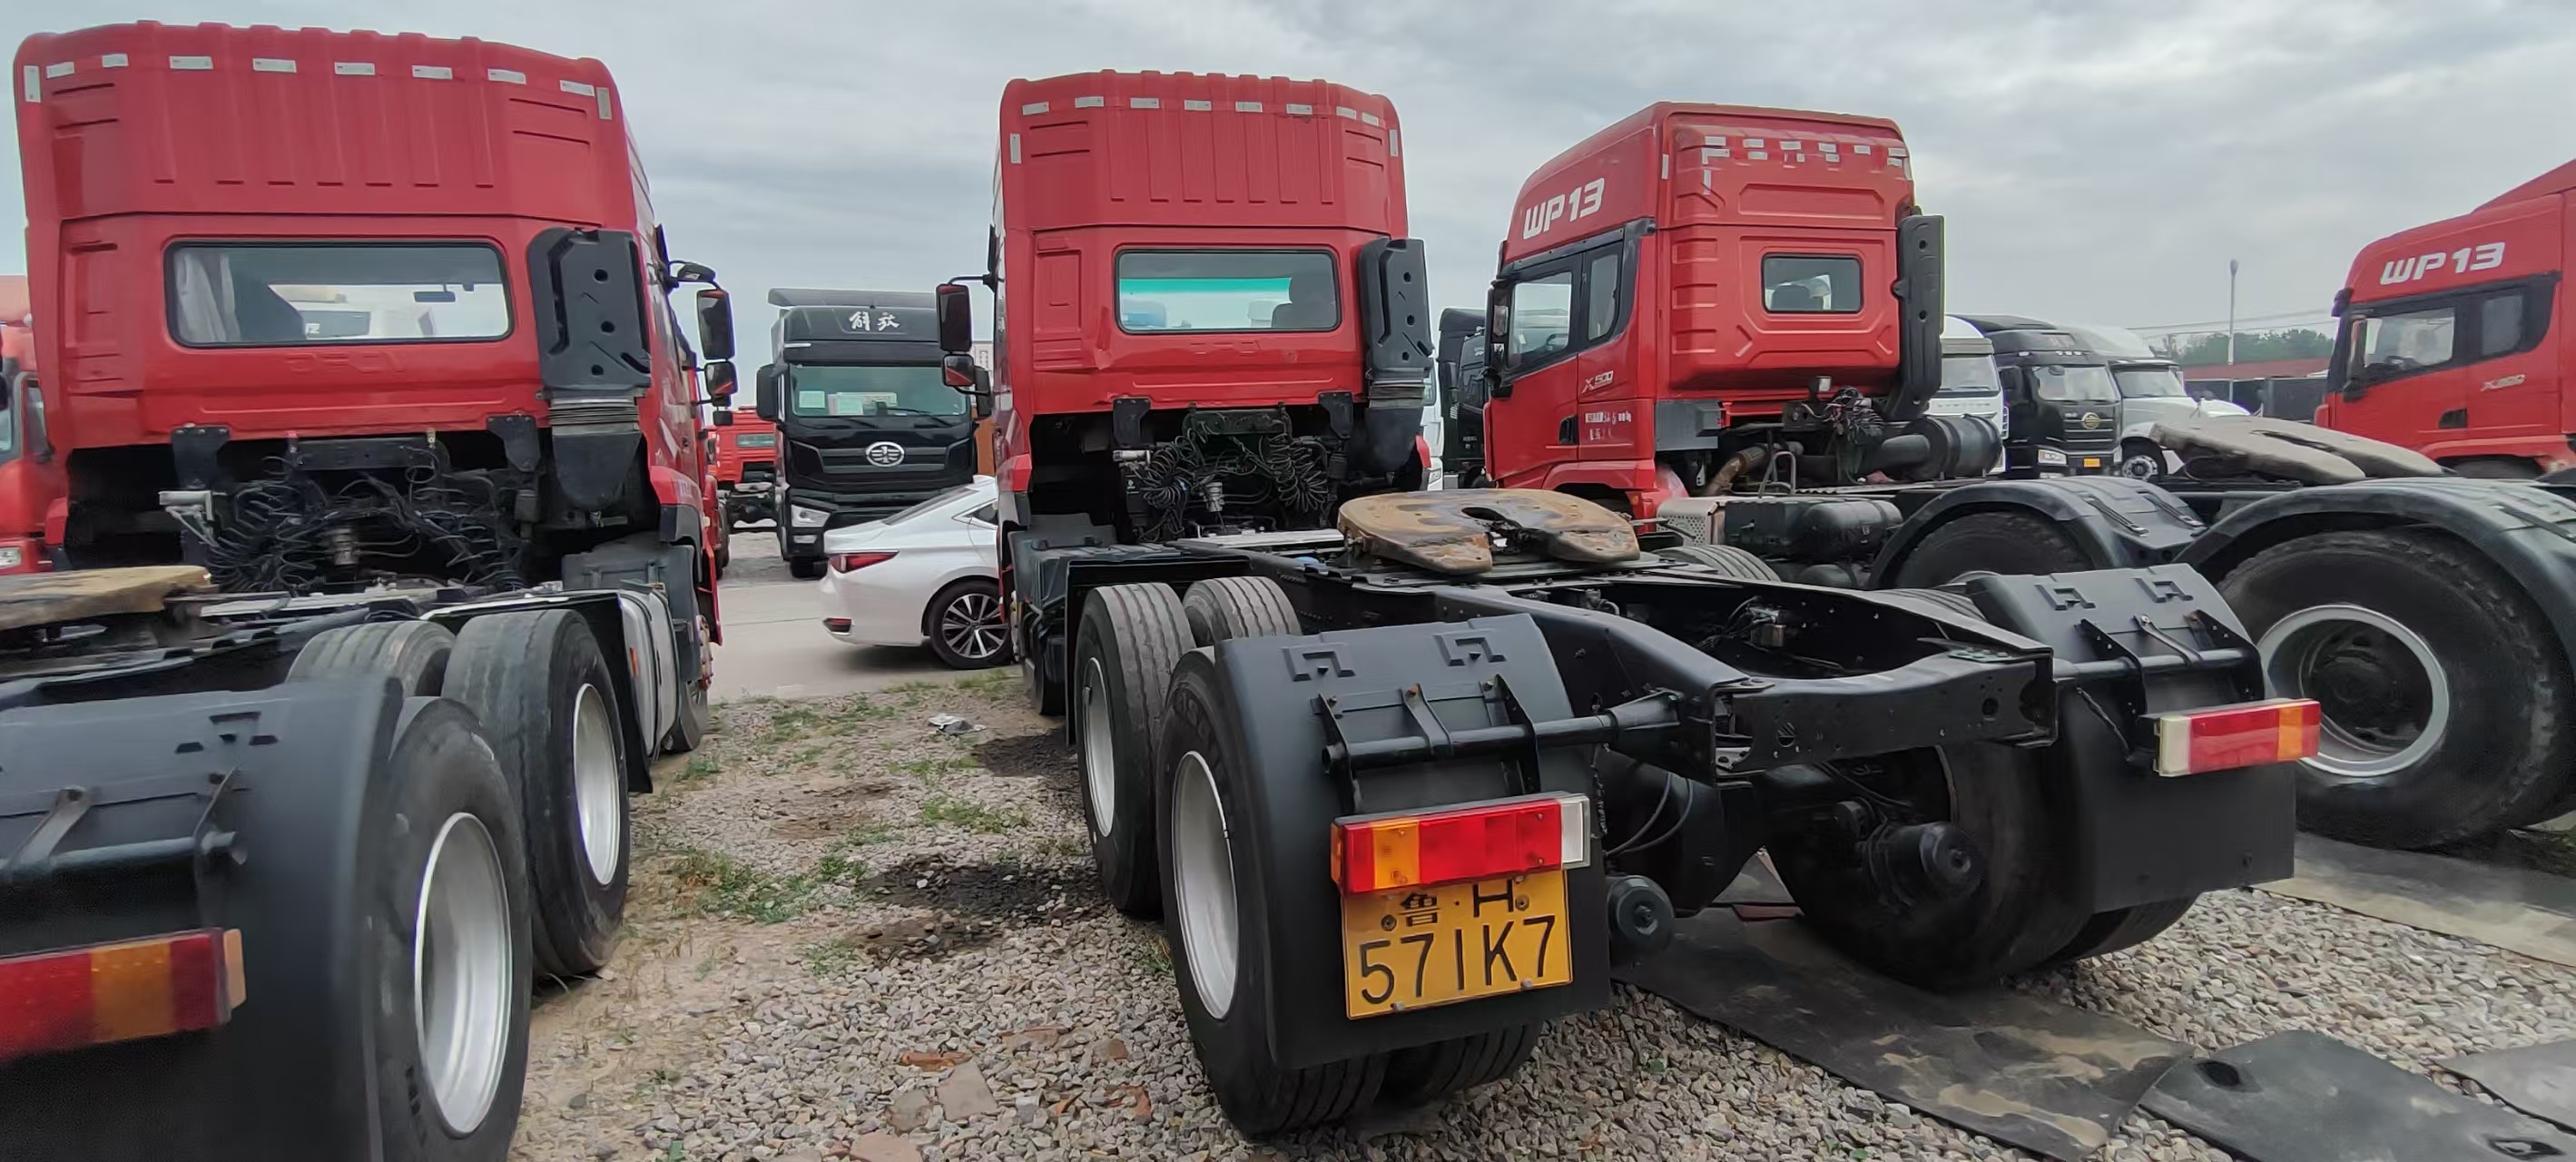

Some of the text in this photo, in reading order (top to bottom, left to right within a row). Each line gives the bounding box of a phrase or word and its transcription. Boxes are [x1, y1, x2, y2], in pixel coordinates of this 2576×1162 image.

[1523, 178, 1605, 240] WP13
[2379, 241, 2505, 285] WP13
[849, 310, 900, 331] 解放
[1359, 914, 1556, 1005] 571K7
